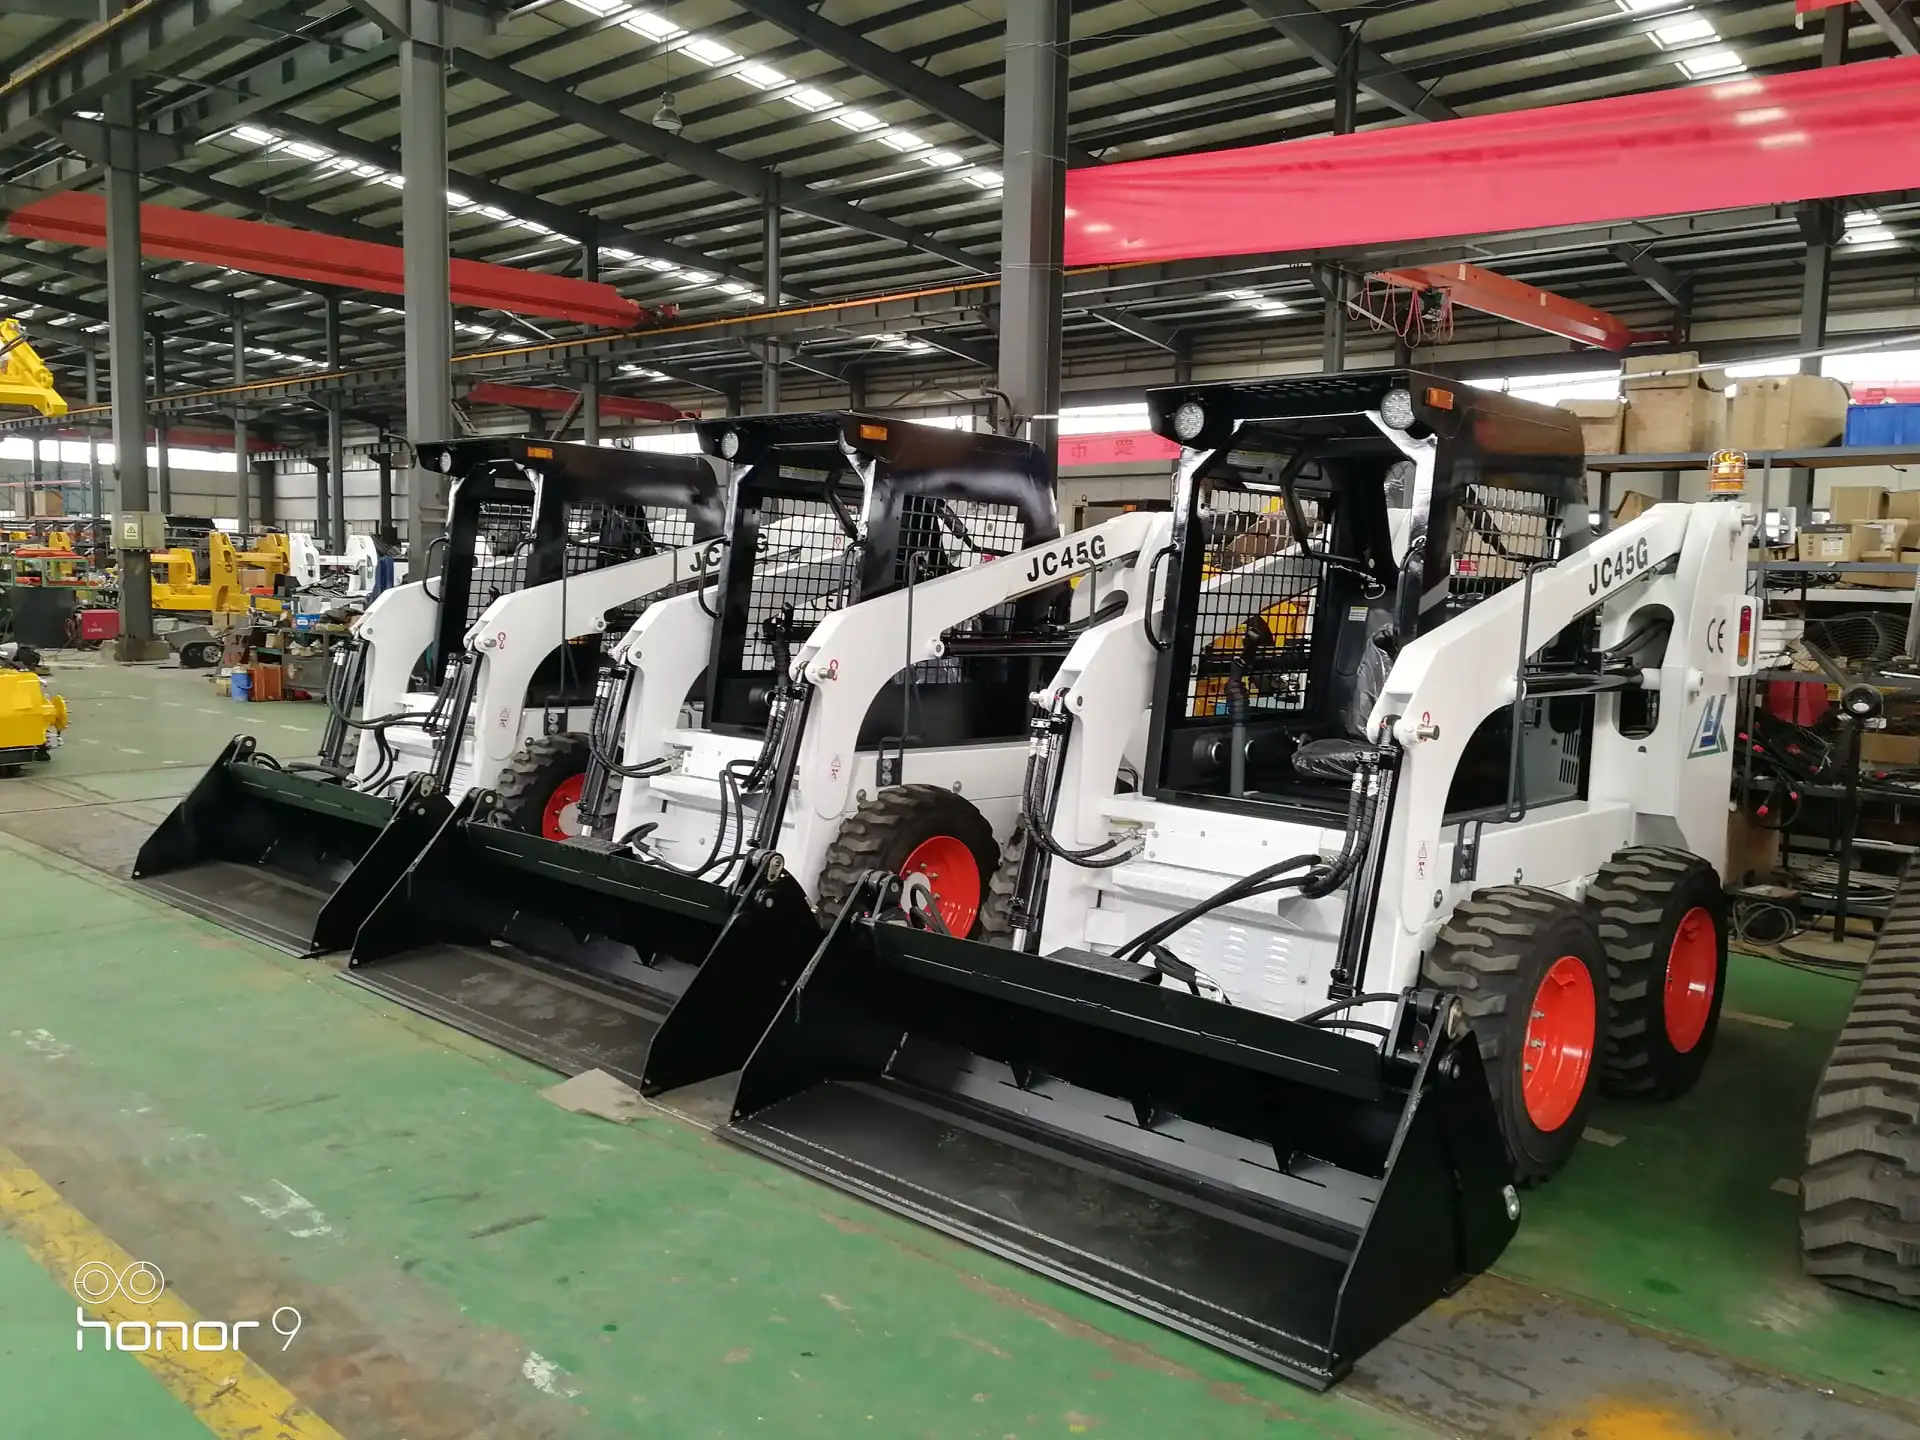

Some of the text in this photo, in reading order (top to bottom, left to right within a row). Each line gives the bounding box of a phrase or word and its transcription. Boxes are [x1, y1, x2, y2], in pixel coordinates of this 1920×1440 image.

[690, 533, 769, 572] JCG
[1027, 534, 1106, 582] JC45G
[1589, 536, 1648, 596] JC45G
[1706, 617, 1726, 654] CE
